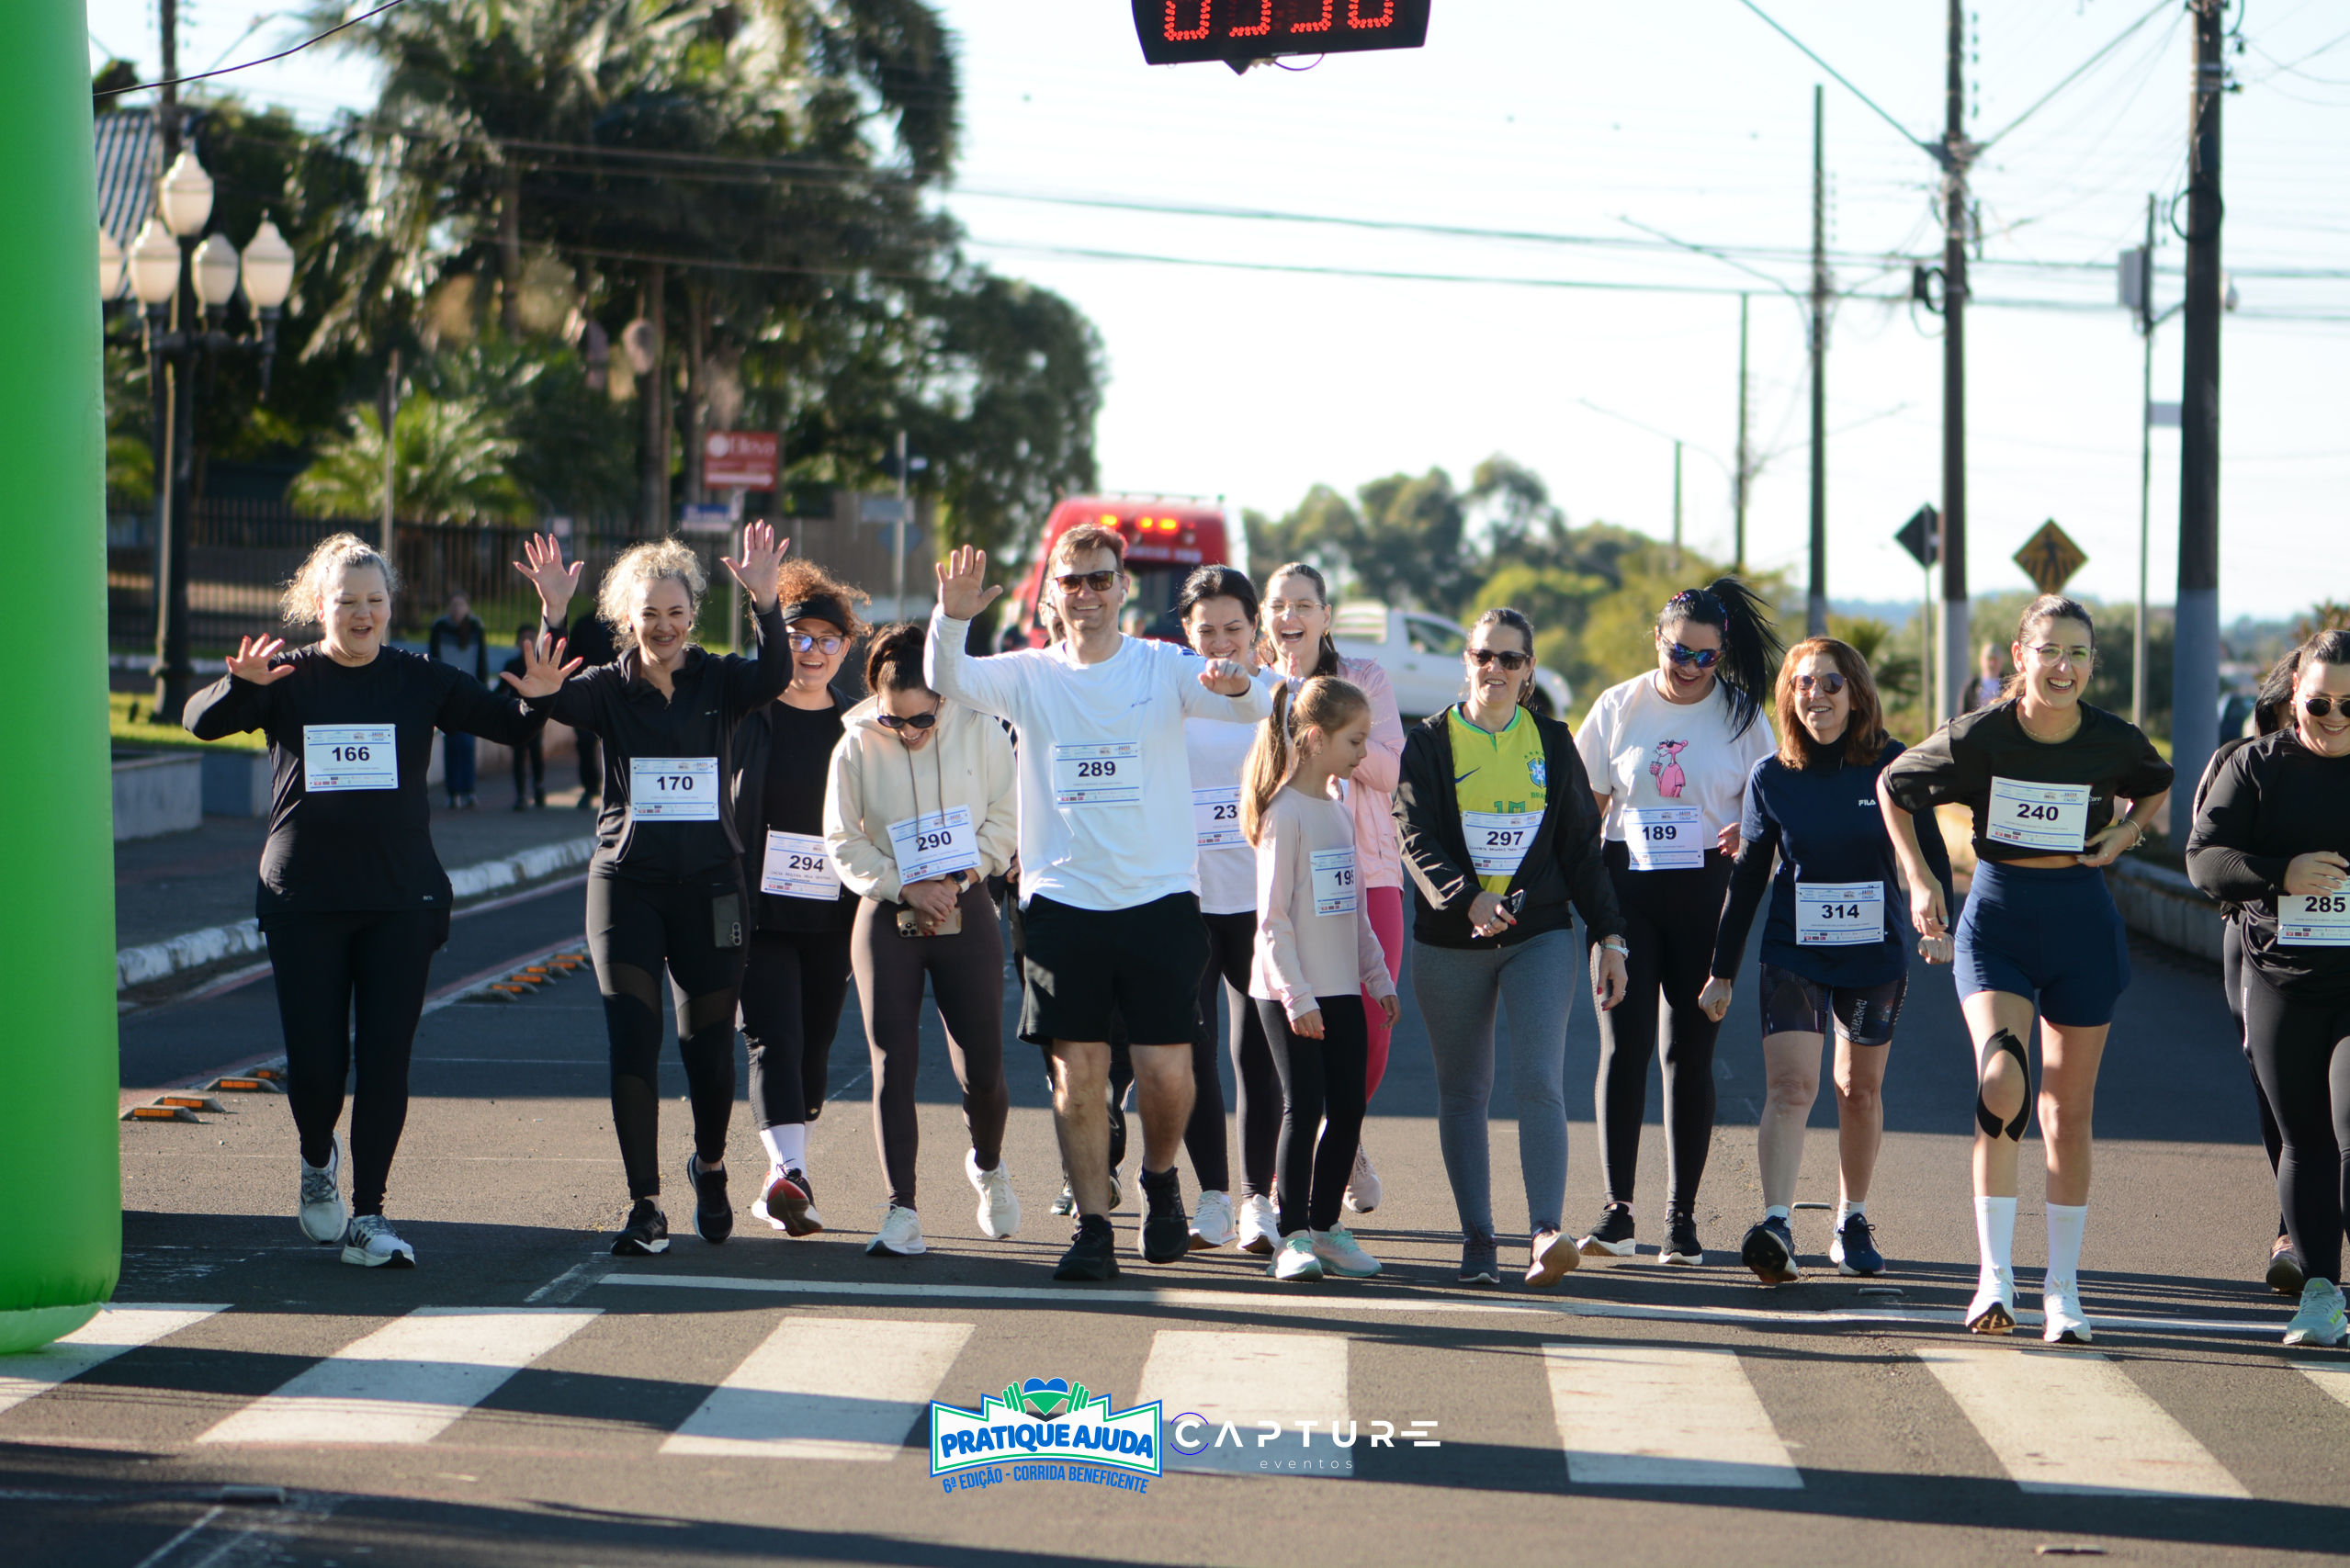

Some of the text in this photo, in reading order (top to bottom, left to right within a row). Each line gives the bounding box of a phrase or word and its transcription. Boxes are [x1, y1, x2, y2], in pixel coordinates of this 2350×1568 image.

[332, 746, 370, 761] 166
[1078, 761, 1116, 777] 289
[657, 775, 694, 791] 170
[1214, 804, 1237, 820] 23
[2017, 803, 2059, 821] 240
[1486, 830, 1524, 846] 297
[1642, 825, 1677, 840] 189
[916, 830, 952, 852] 290
[789, 854, 824, 873] 294
[1821, 904, 1859, 919] 314
[2305, 896, 2346, 912] 285
